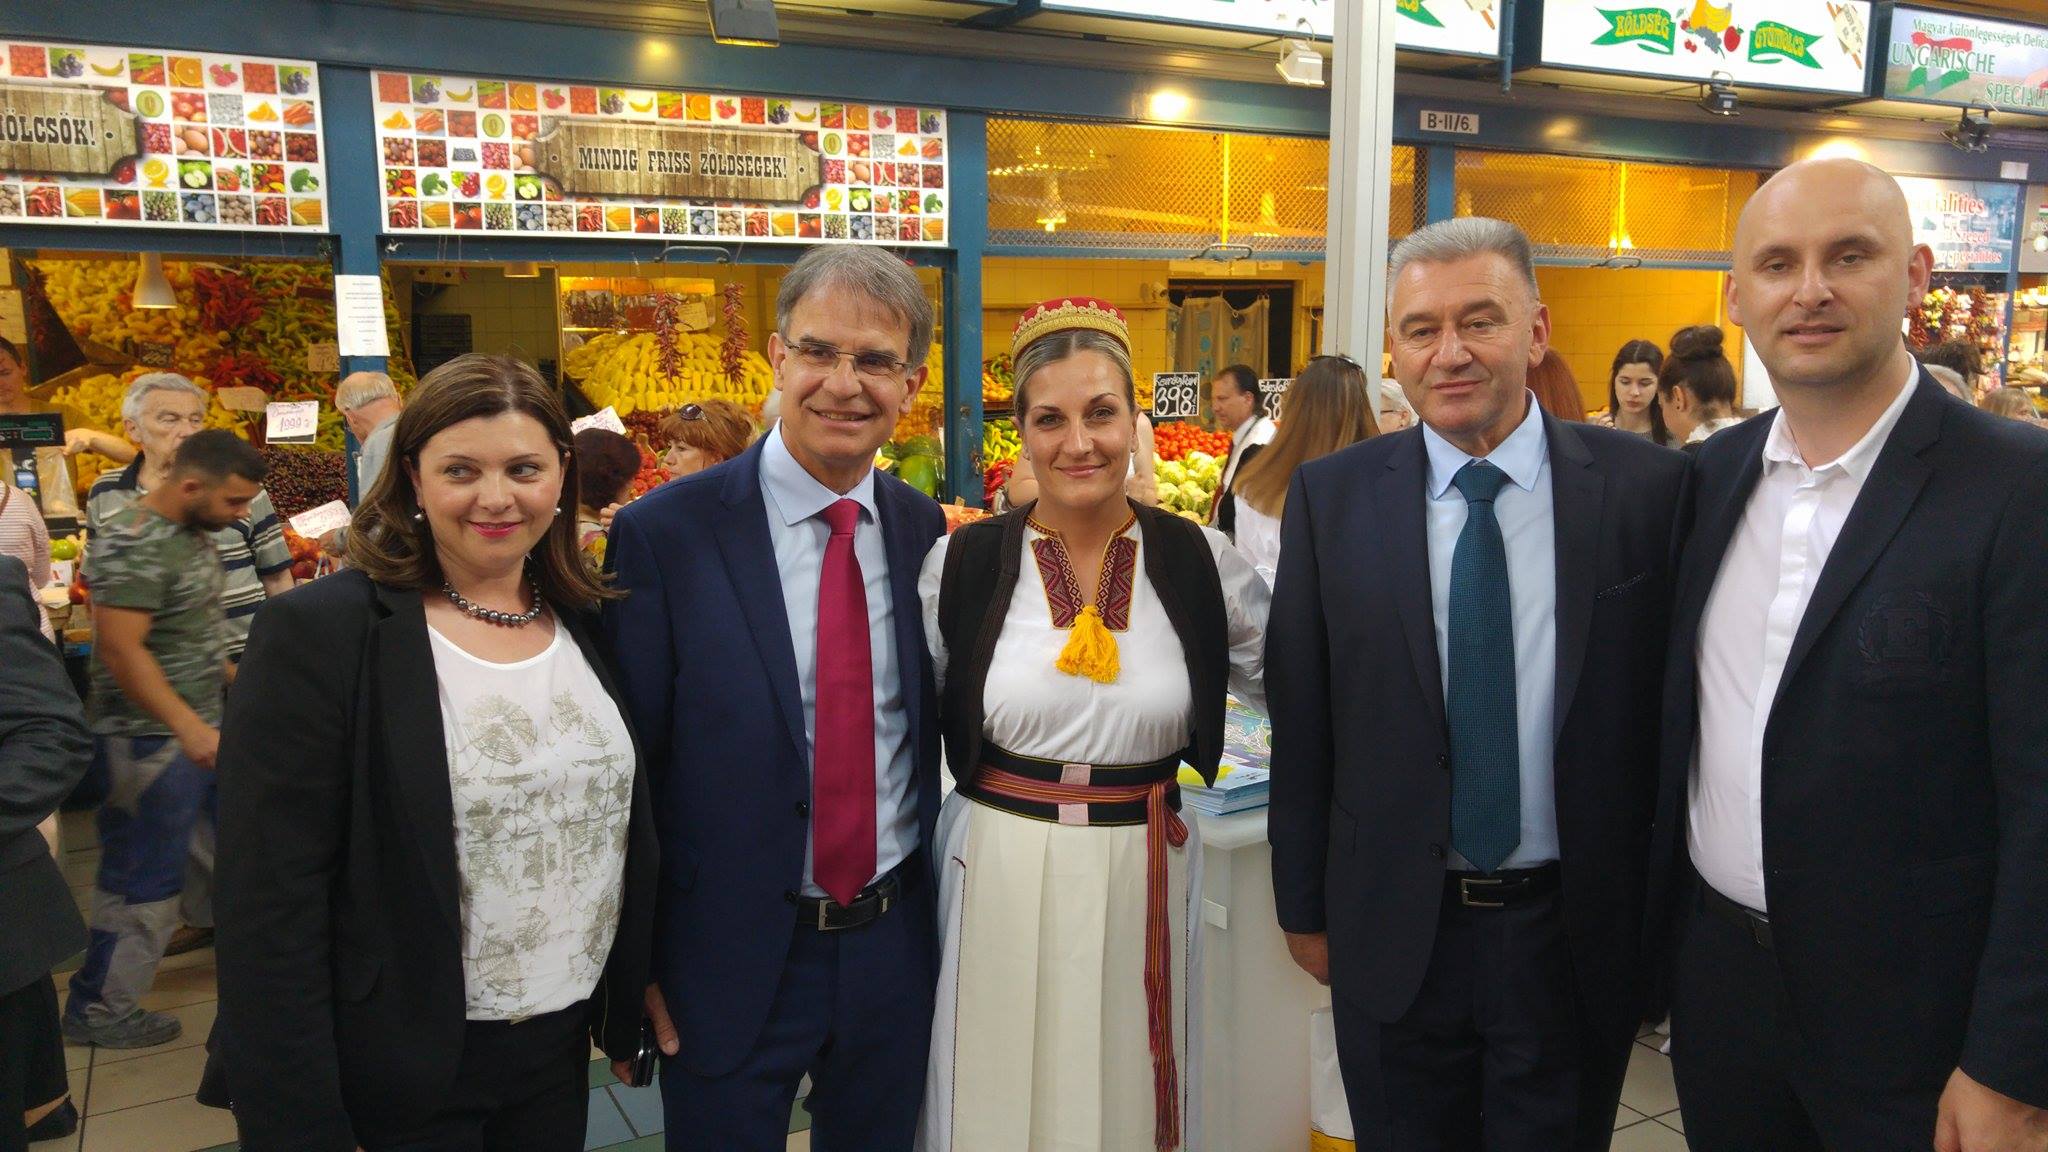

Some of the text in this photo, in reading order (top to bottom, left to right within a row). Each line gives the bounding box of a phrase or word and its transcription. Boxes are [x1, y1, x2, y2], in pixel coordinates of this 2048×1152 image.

[1913, 18, 1946, 34] Magyar
[1949, 22, 2022, 47] különlegességek
[1891, 42, 1996, 74] UNGARISCHE
[0, 109, 96, 146] ÖLCSÖK!
[579, 147, 787, 178] MINDIG FRISS ZÖLDSÉGEK!
